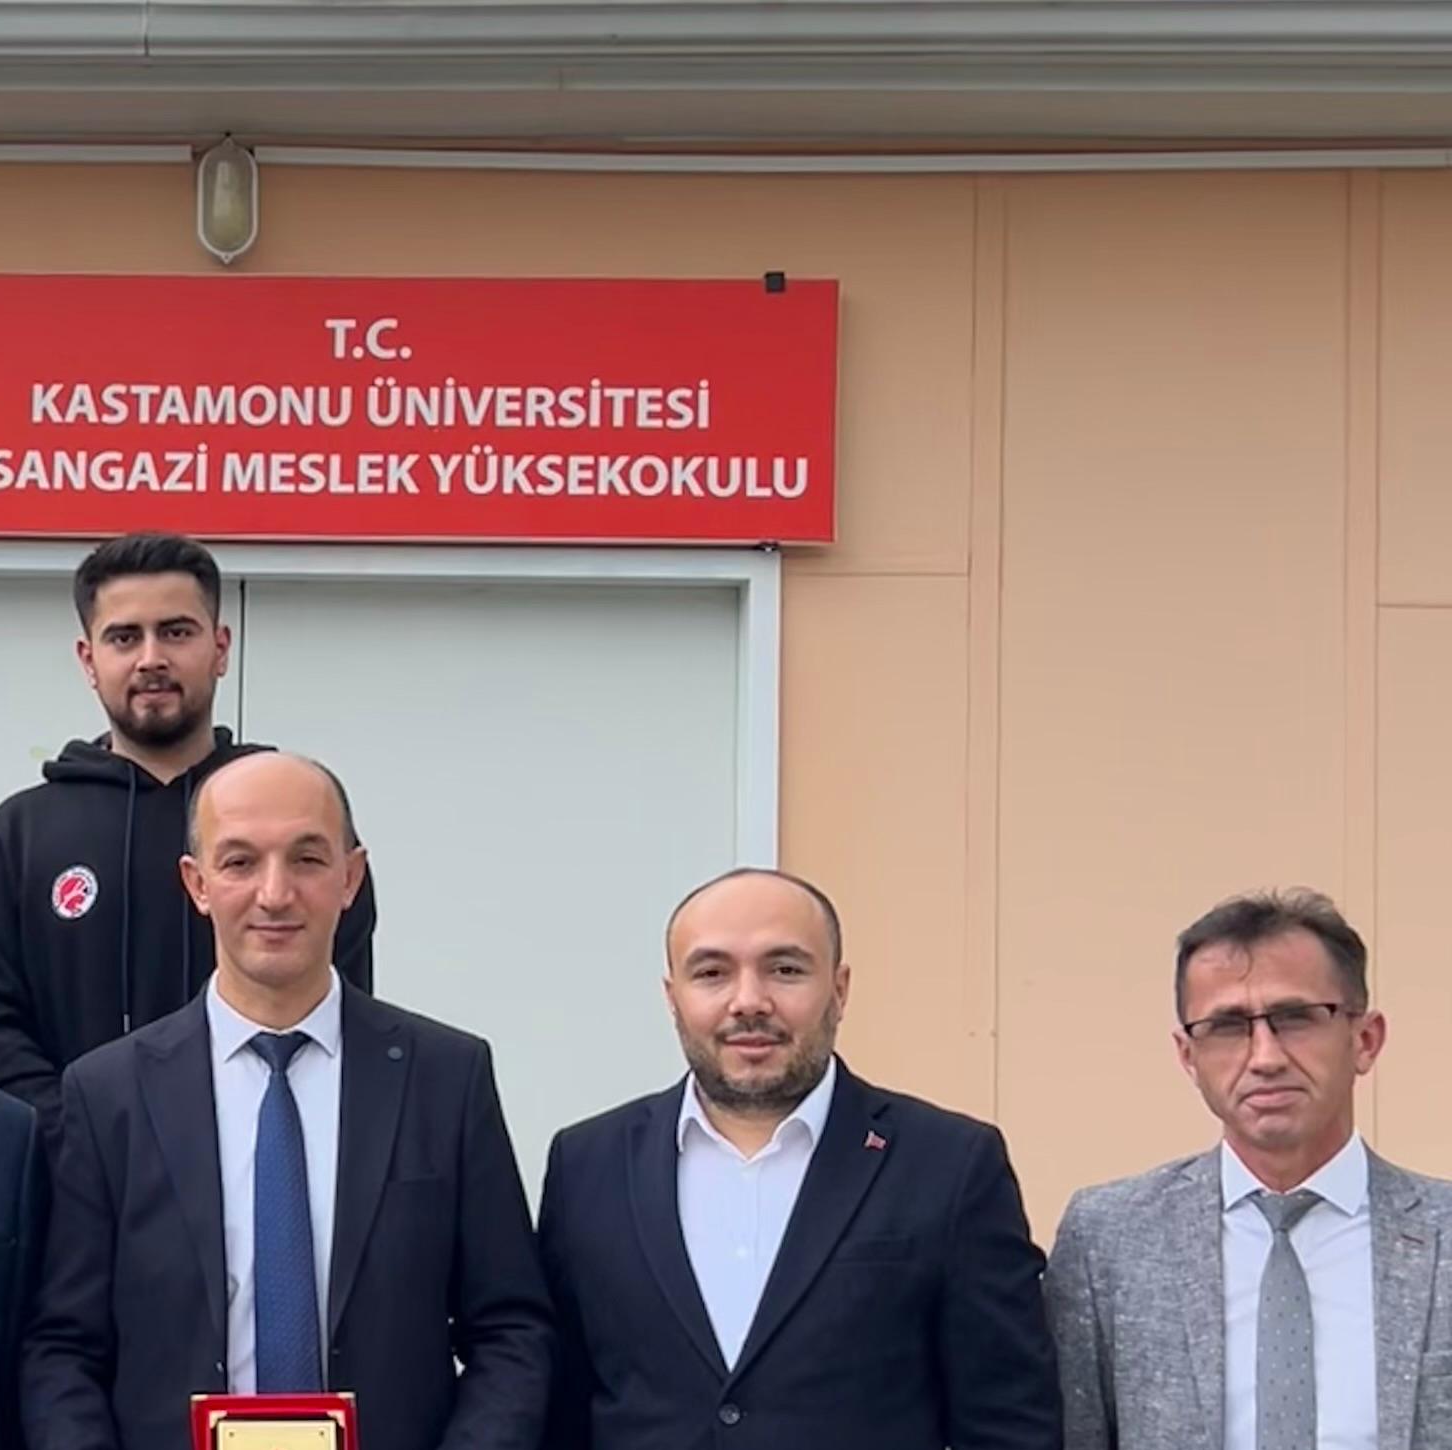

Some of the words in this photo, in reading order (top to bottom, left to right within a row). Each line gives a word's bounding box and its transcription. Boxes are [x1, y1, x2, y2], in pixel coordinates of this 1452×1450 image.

[325, 318, 412, 359] T.C.
[32, 383, 352, 426] KASTAMONU
[367, 377, 710, 429] ÜNİVERSİTESİ
[222, 452, 420, 494] MESLEK
[429, 444, 809, 498] YÜKSEKOKULU
